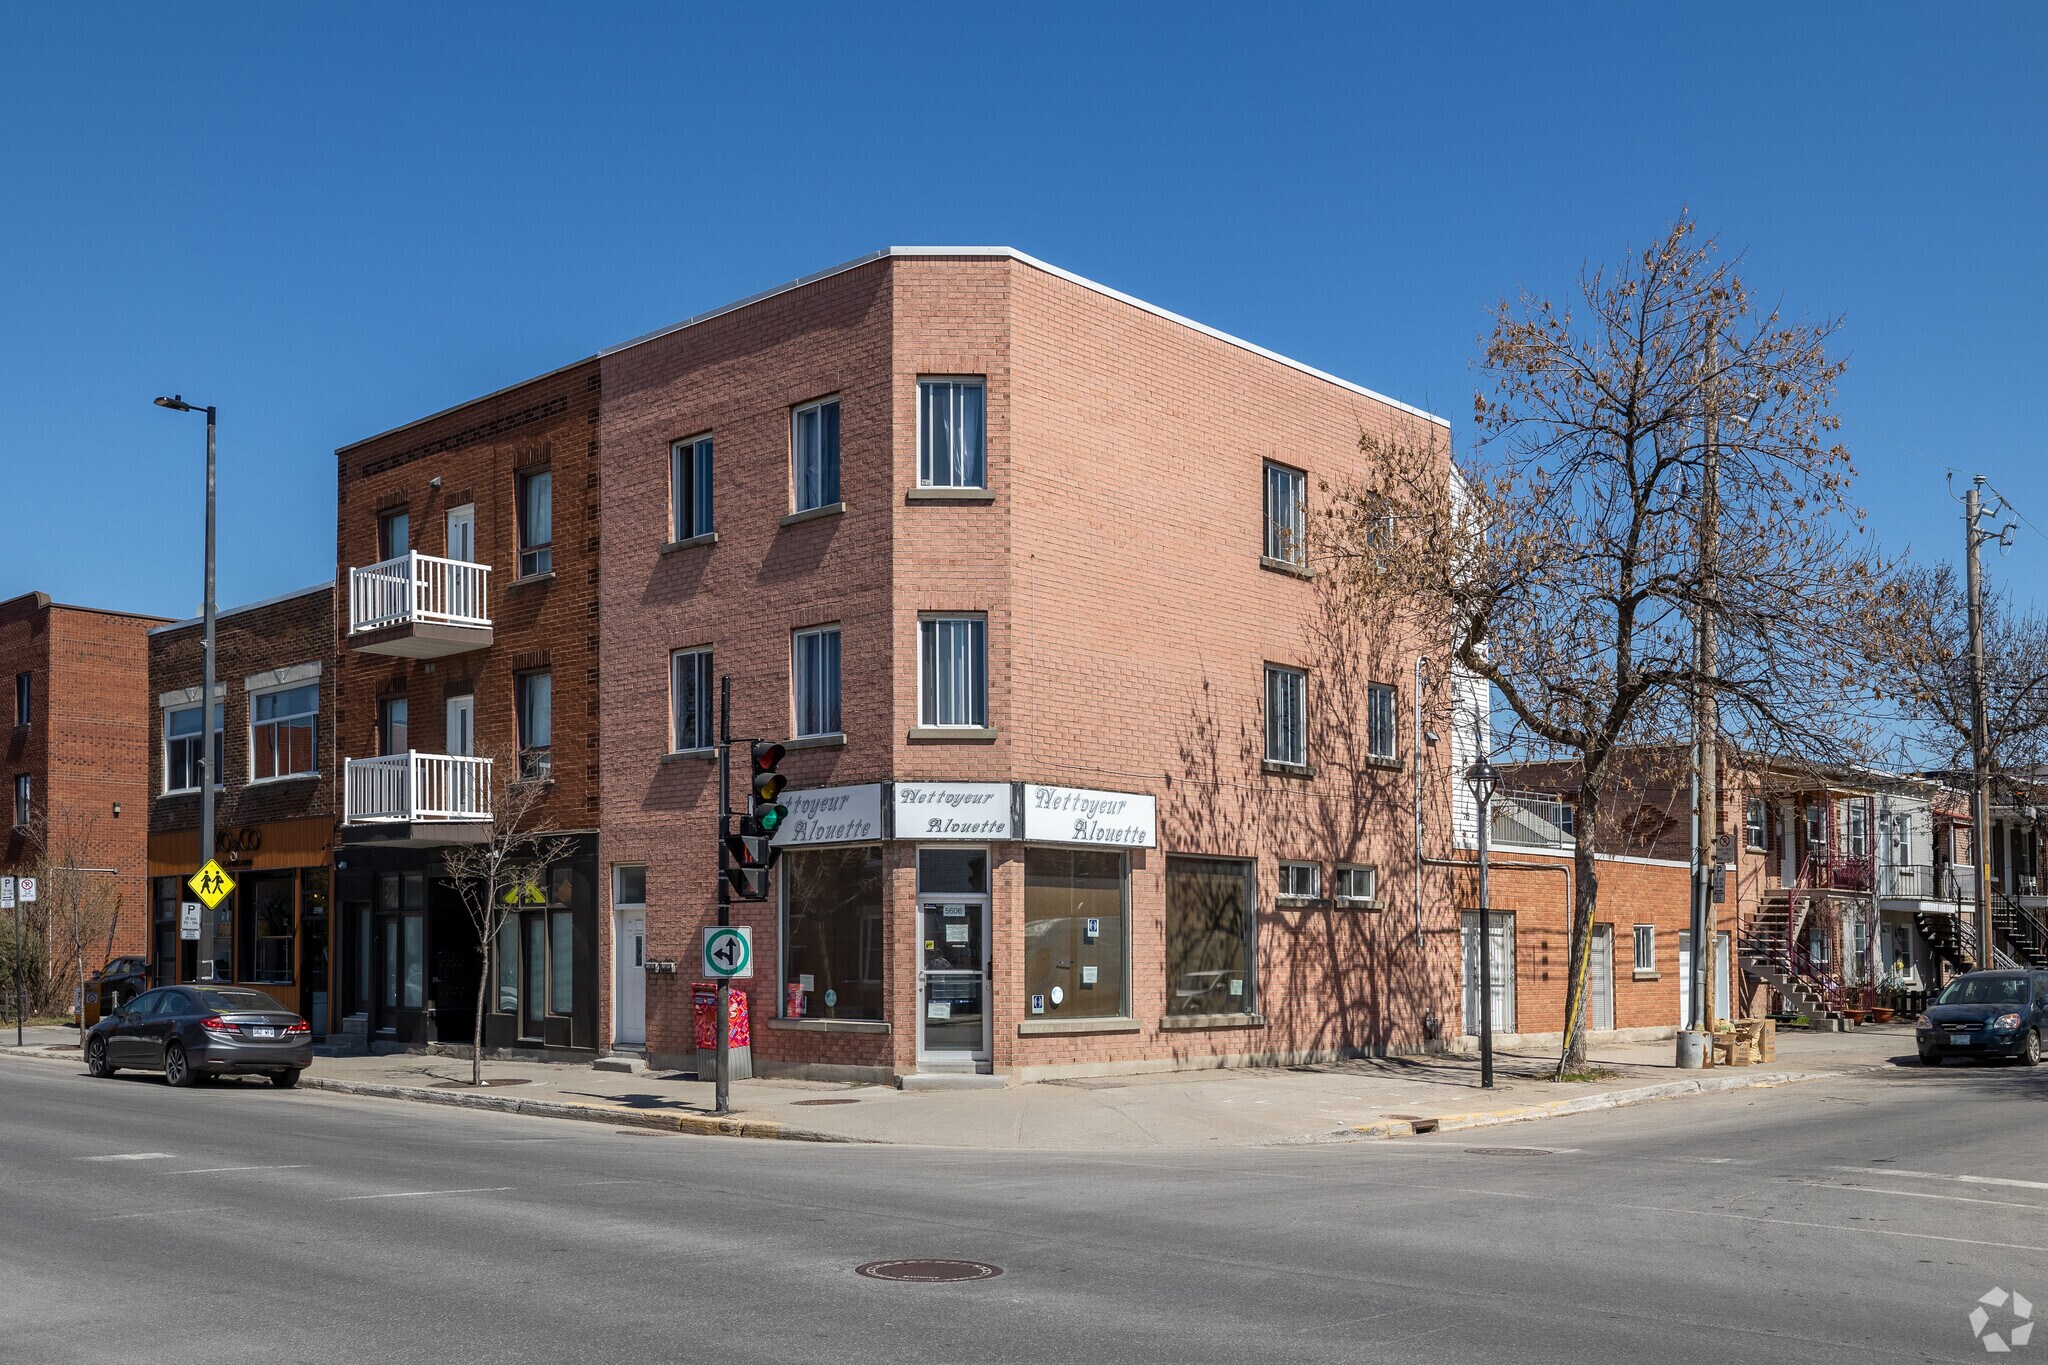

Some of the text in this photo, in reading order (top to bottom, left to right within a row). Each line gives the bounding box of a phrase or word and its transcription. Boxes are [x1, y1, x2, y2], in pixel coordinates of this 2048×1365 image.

[781, 794, 850, 819] ttoyeur
[900, 788, 994, 807] Nettoyeur
[1034, 786, 1127, 819] Nettoyeur
[791, 819, 871, 841] Alouette
[926, 818, 1005, 833] Alouette
[1071, 818, 1147, 843] Alouette
[1717, 866, 1722, 876] P
[5, 879, 10, 887] P
[188, 905, 195, 914] P
